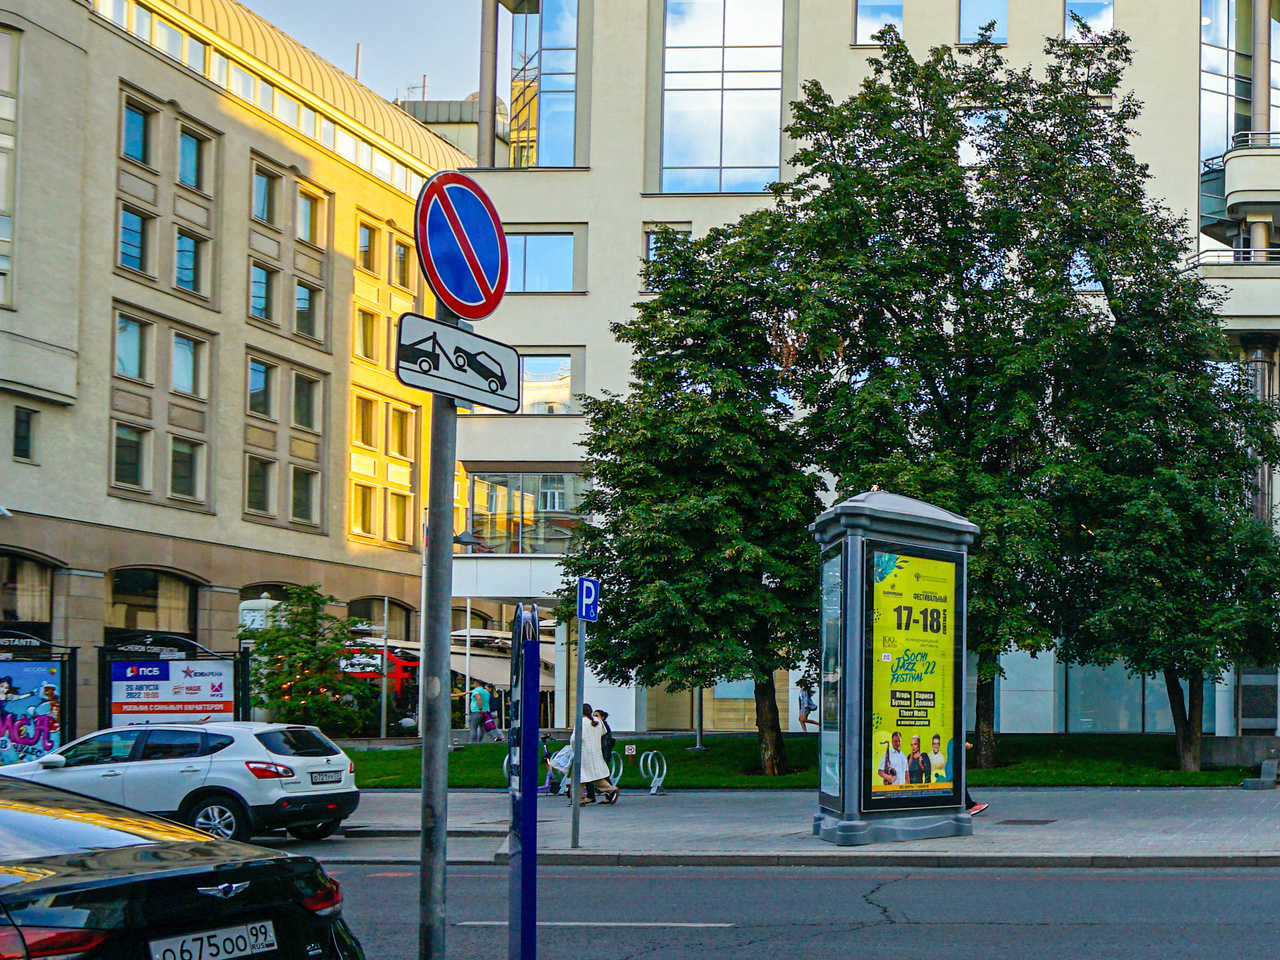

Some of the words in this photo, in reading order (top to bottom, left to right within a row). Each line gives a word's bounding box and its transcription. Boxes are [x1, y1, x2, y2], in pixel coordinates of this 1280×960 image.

[582, 580, 596, 617] P
[893, 605, 942, 634] 17-18
[139, 667, 160, 676] ПСБ
[135, 684, 159, 692] АВГУСТА
[125, 691, 142, 699] 2022
[250, 924, 268, 943] 99
[251, 943, 266, 951] RUS
